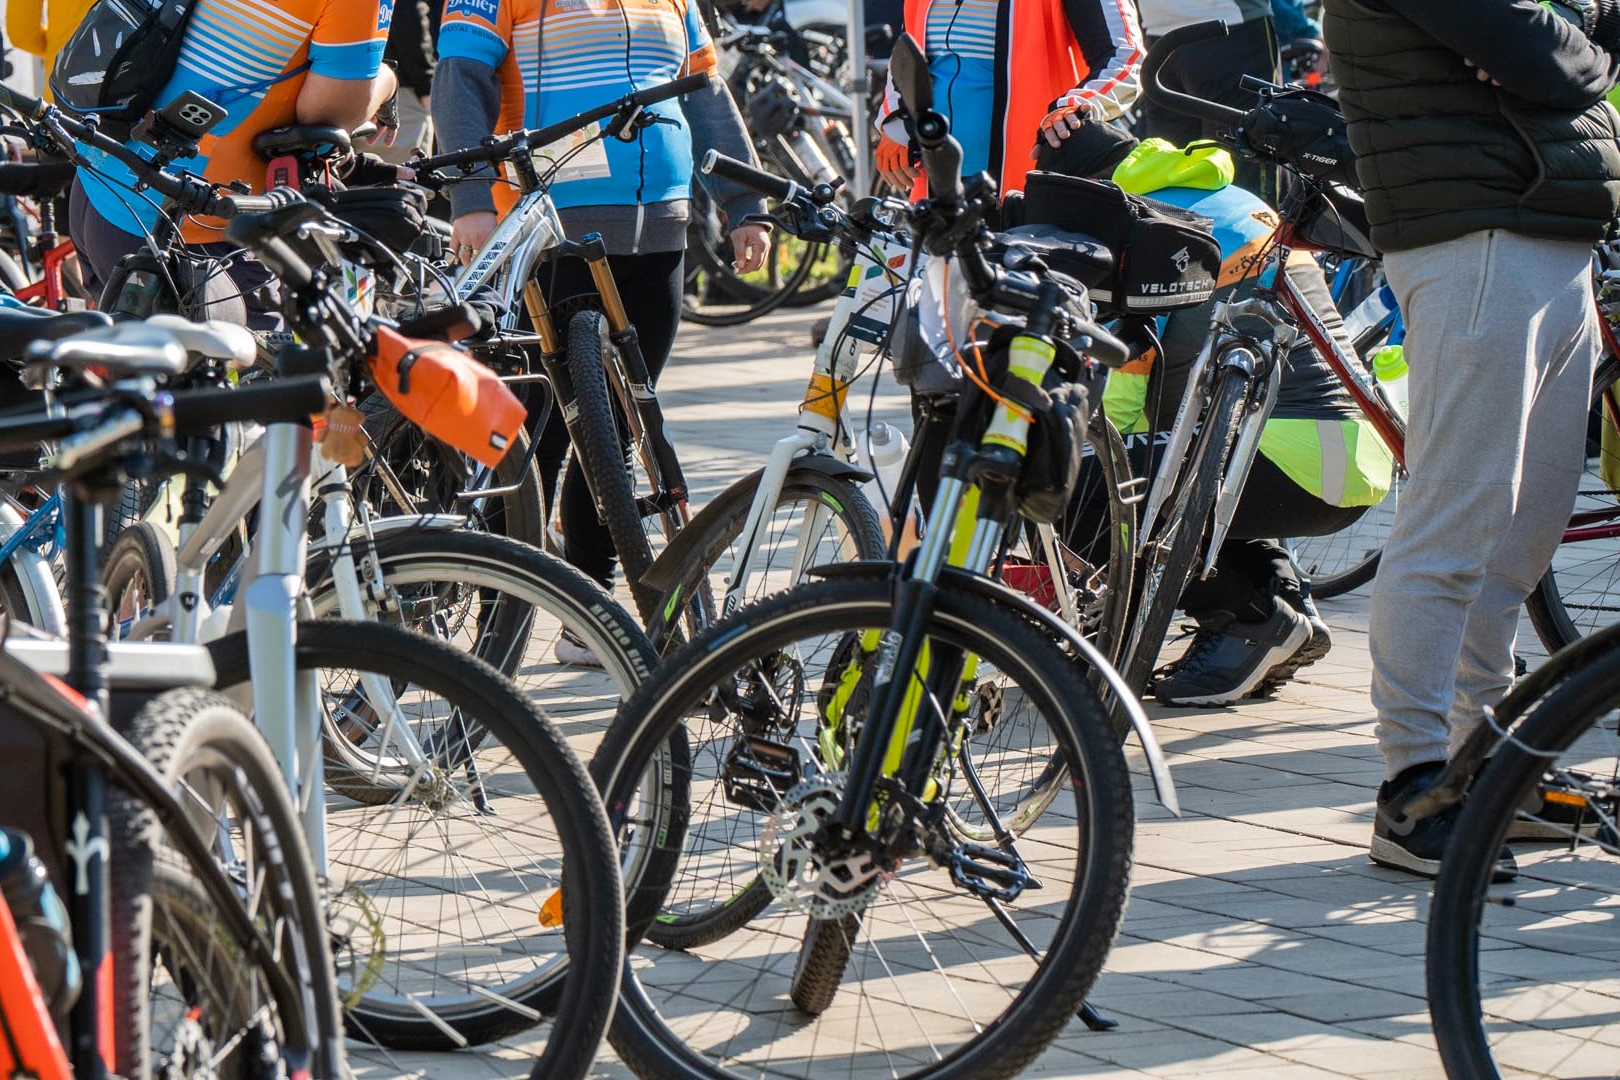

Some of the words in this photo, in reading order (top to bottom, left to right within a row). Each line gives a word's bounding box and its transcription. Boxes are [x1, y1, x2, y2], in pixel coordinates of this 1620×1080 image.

[1302, 152, 1338, 166] X-TIGER
[1140, 280, 1210, 294] VELOTECH
[626, 648, 653, 680] ELIT
